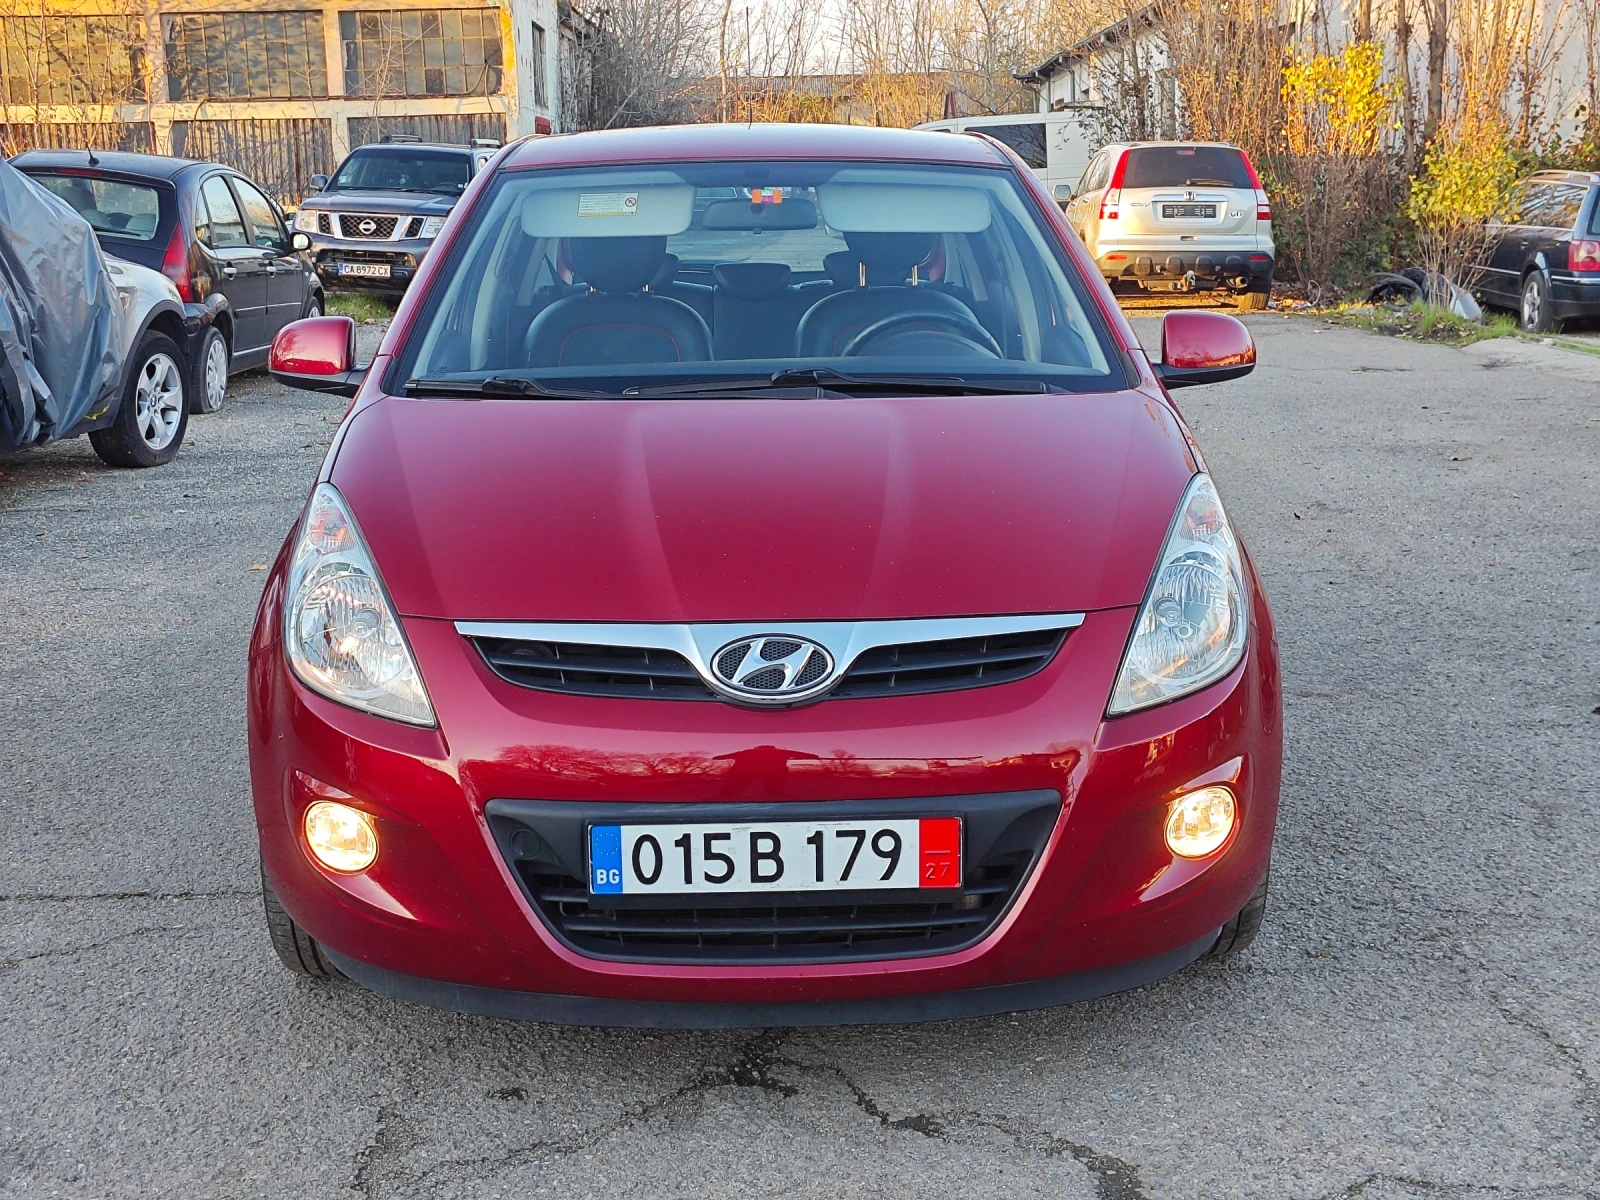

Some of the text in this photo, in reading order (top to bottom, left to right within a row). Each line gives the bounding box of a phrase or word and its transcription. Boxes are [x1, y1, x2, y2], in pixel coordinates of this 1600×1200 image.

[806, 828, 902, 882] 179
[596, 869, 620, 885] BG
[925, 861, 951, 879] 27
